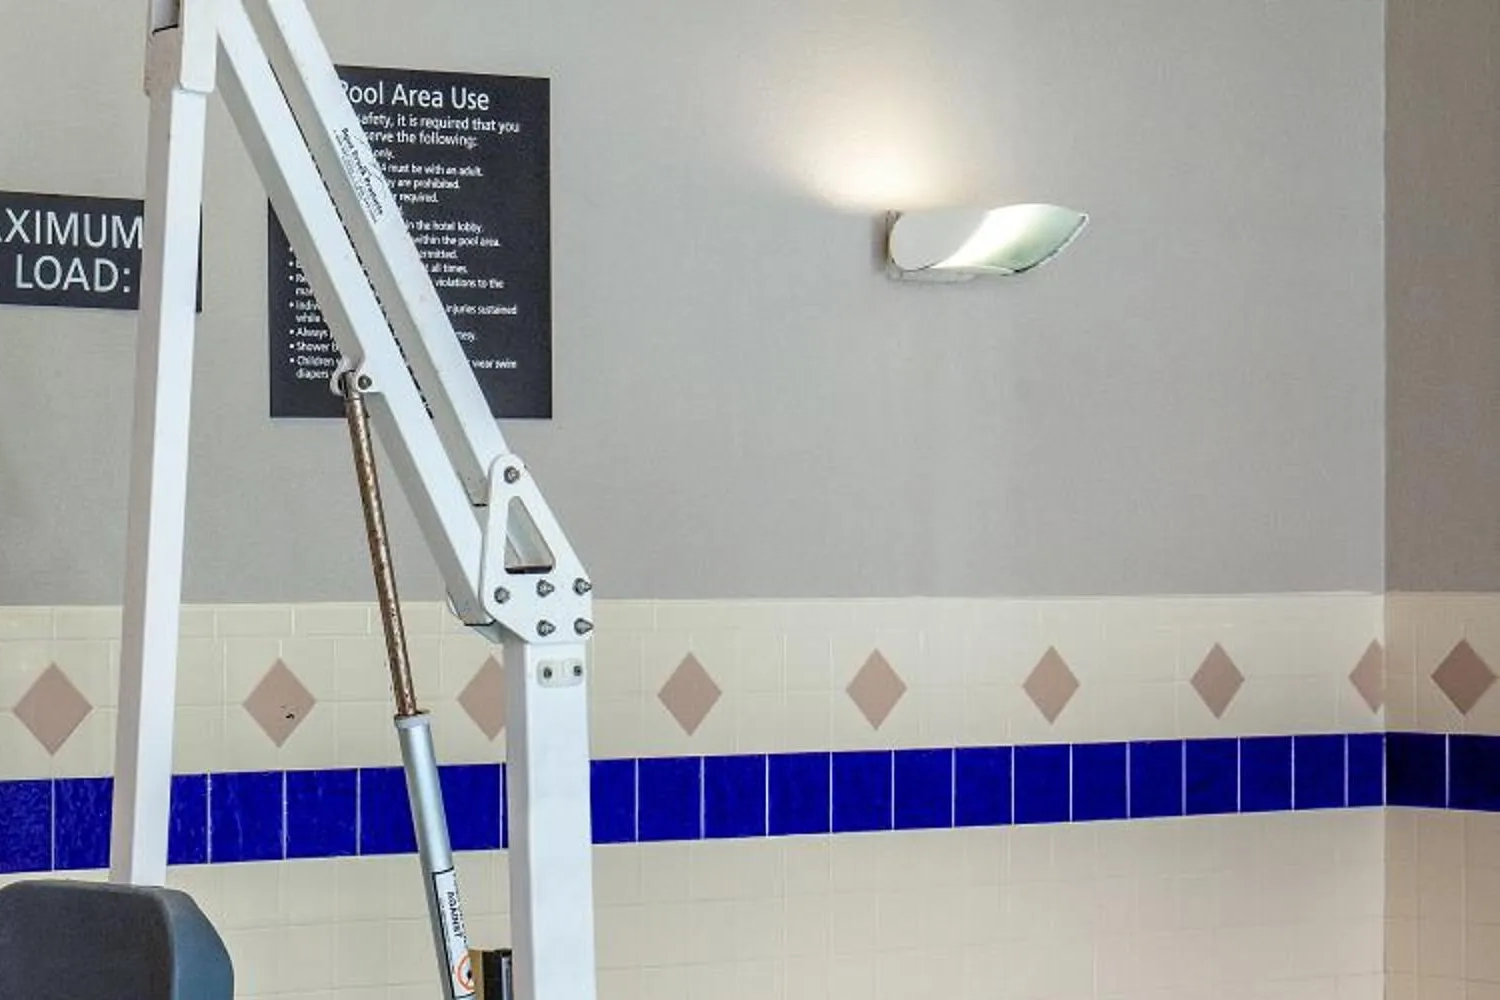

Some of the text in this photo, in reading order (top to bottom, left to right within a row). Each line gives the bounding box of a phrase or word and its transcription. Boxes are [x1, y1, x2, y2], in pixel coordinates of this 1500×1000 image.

[391, 83, 443, 107] Area
[451, 87, 489, 110] Use
[396, 129, 415, 143] the
[419, 117, 468, 130] required
[472, 117, 496, 131] that
[497, 121, 519, 135] you
[15, 253, 131, 293] LOAD:
